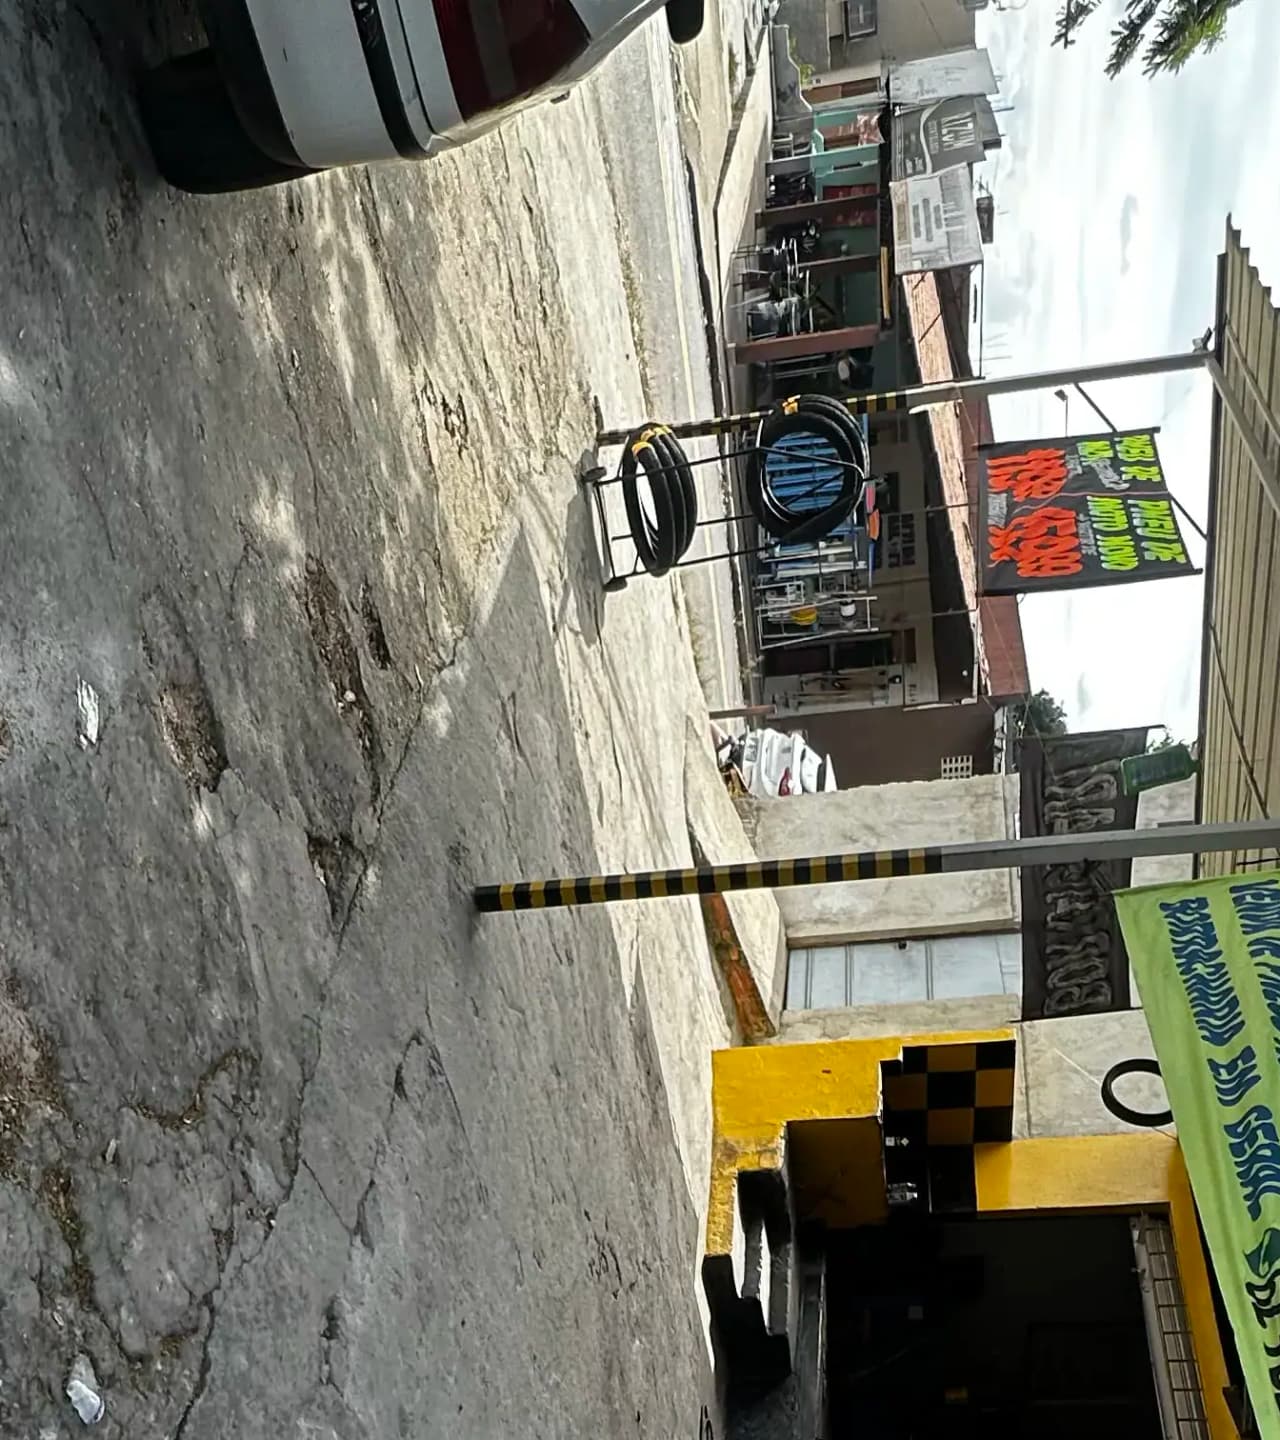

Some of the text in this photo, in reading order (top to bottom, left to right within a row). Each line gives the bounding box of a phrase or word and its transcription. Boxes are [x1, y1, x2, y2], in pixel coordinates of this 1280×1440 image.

[1122, 466, 1161, 482] DE
[1087, 496, 1139, 571] MOTO NOVO
[1128, 499, 1185, 563] PNEU DE
[1207, 1046, 1261, 1106] EM
